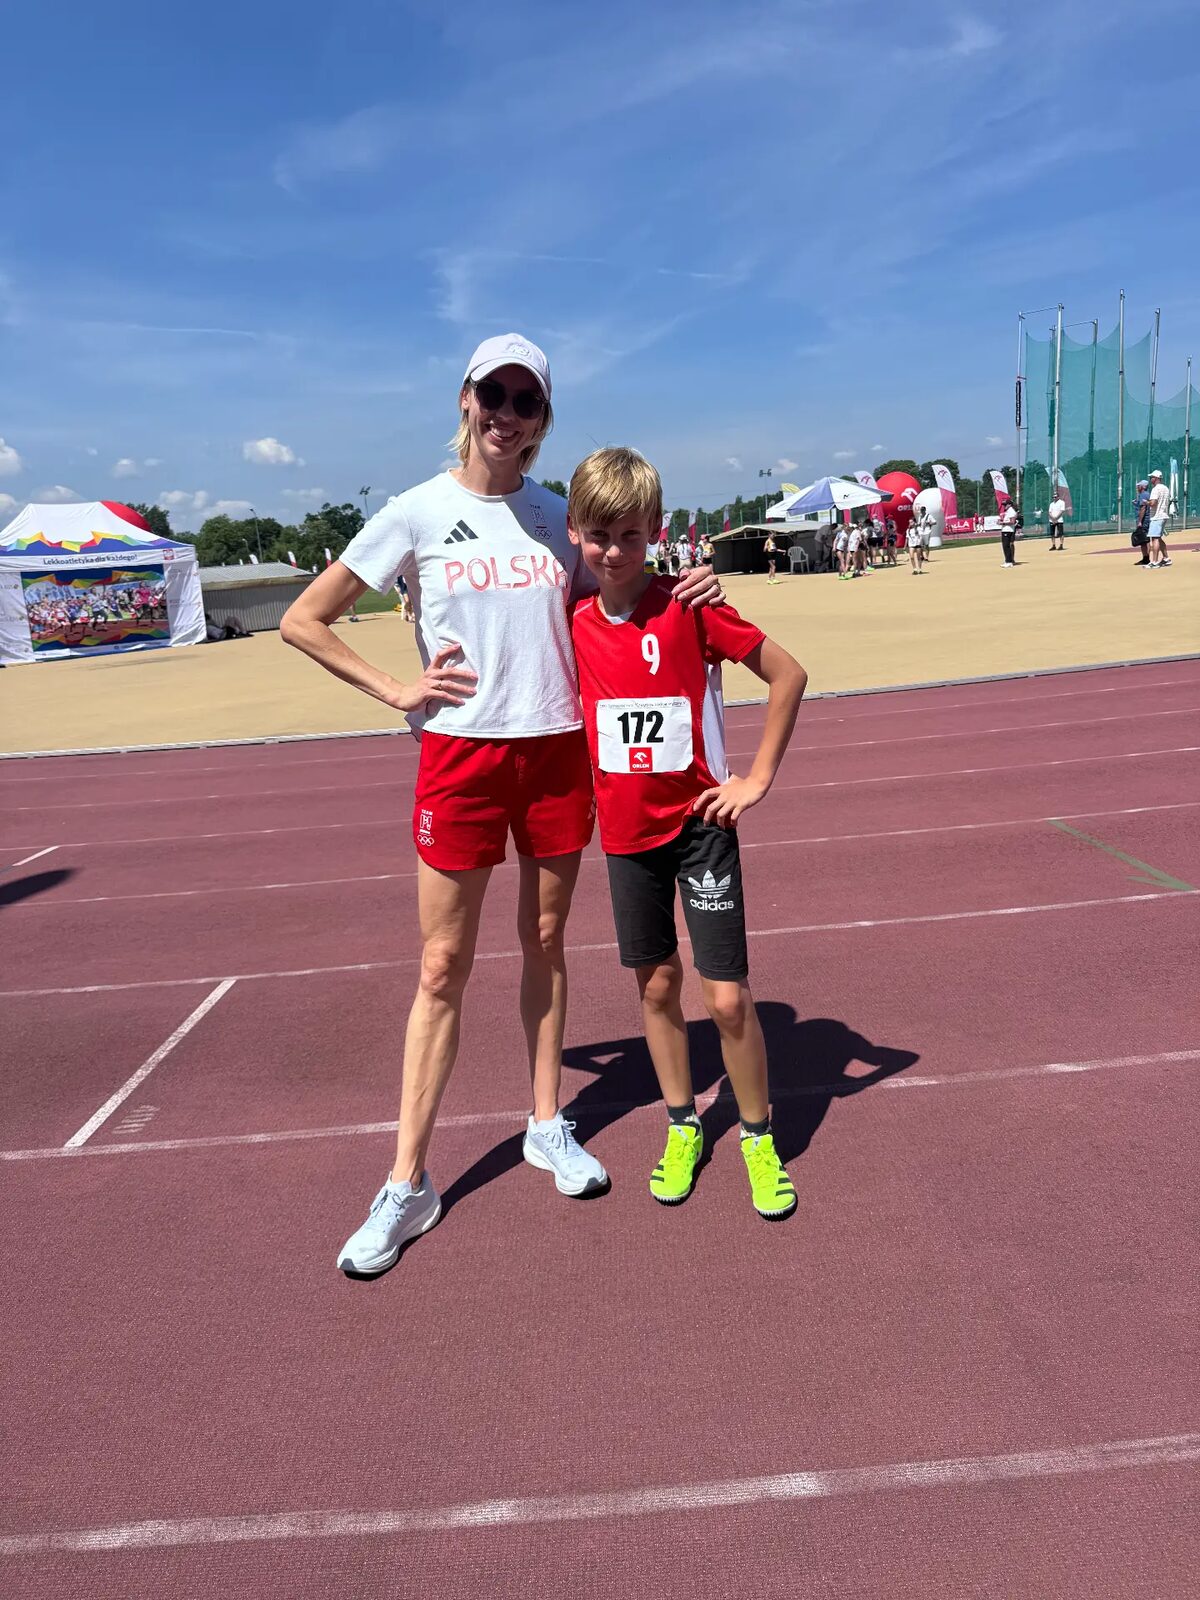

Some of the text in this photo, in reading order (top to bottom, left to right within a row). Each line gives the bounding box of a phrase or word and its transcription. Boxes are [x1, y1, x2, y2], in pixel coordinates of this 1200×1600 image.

[43, 556, 94, 566] Lekkoatletyka
[444, 555, 568, 597] POLSKA
[641, 633, 661, 676] 9
[617, 710, 664, 744] 172
[689, 898, 735, 911] adidas
